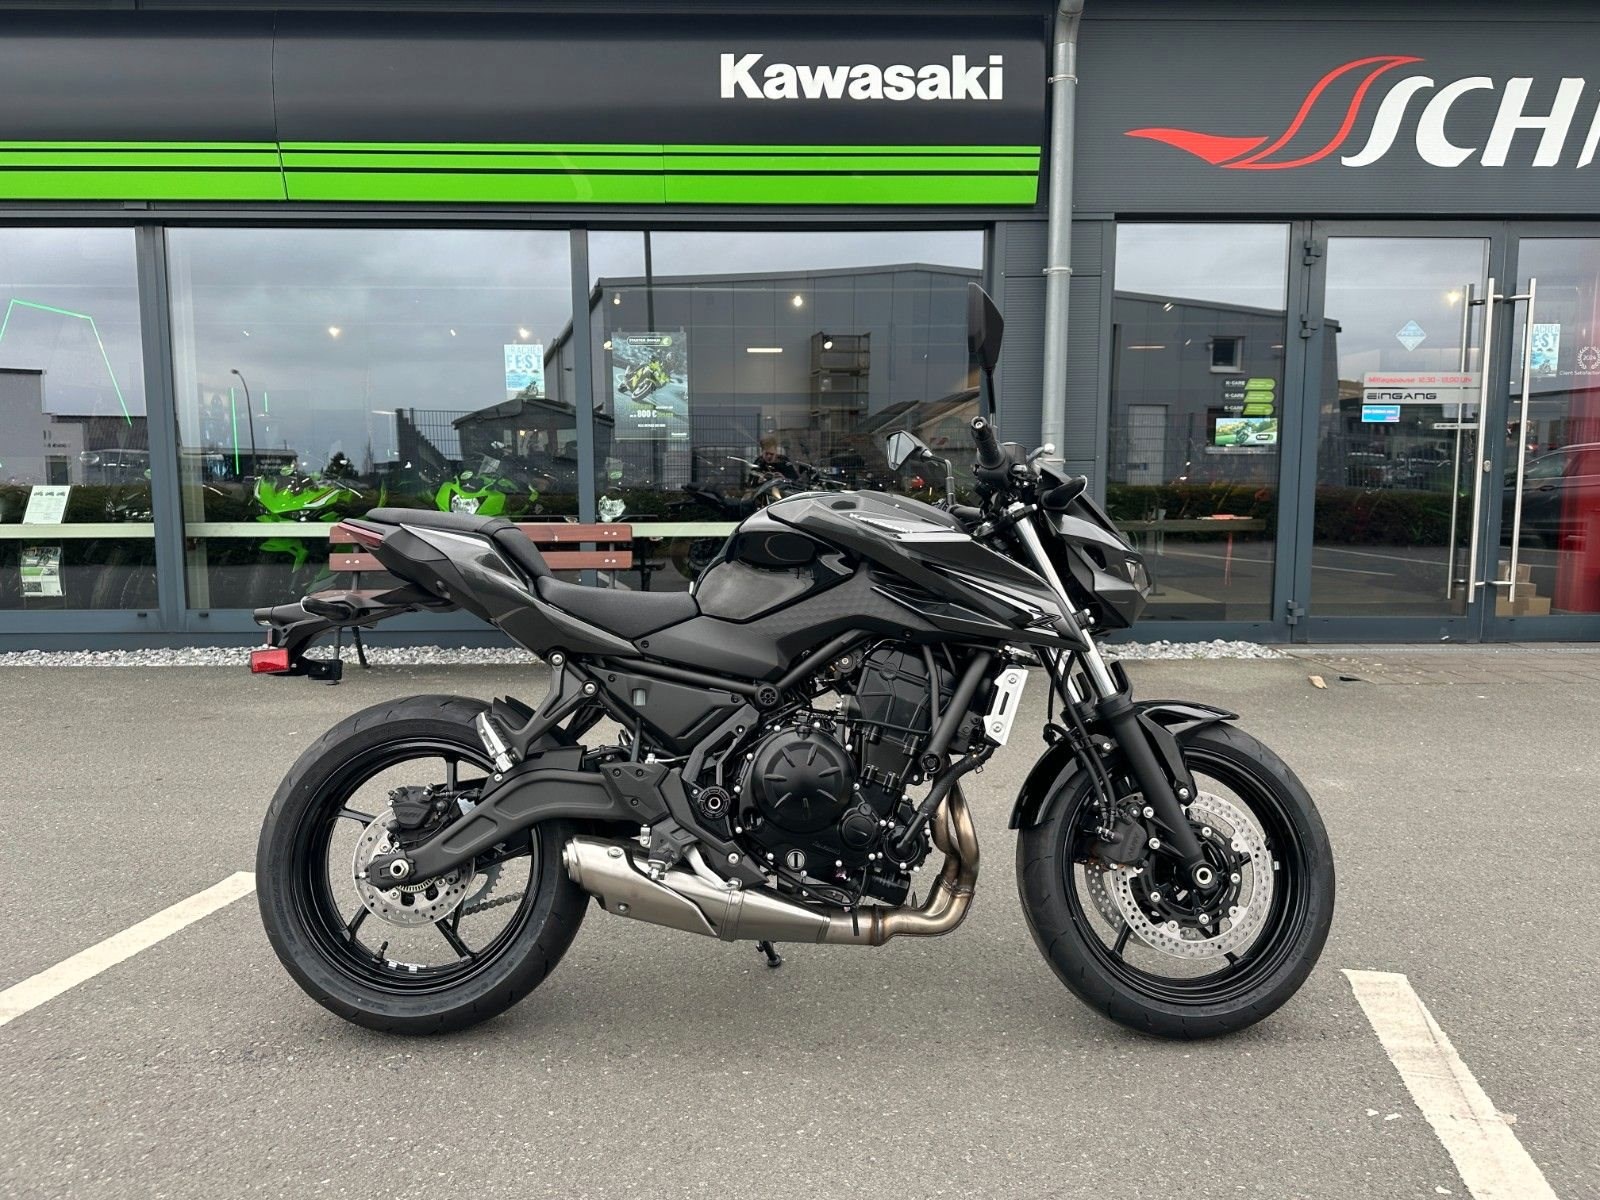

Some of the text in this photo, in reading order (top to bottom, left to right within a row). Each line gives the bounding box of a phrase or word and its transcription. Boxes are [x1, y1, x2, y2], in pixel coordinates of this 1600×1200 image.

[720, 53, 1003, 100] Kawasaki
[1341, 75, 1600, 168] SCH
[1532, 333, 1558, 347] EST
[637, 409, 651, 418] 800
